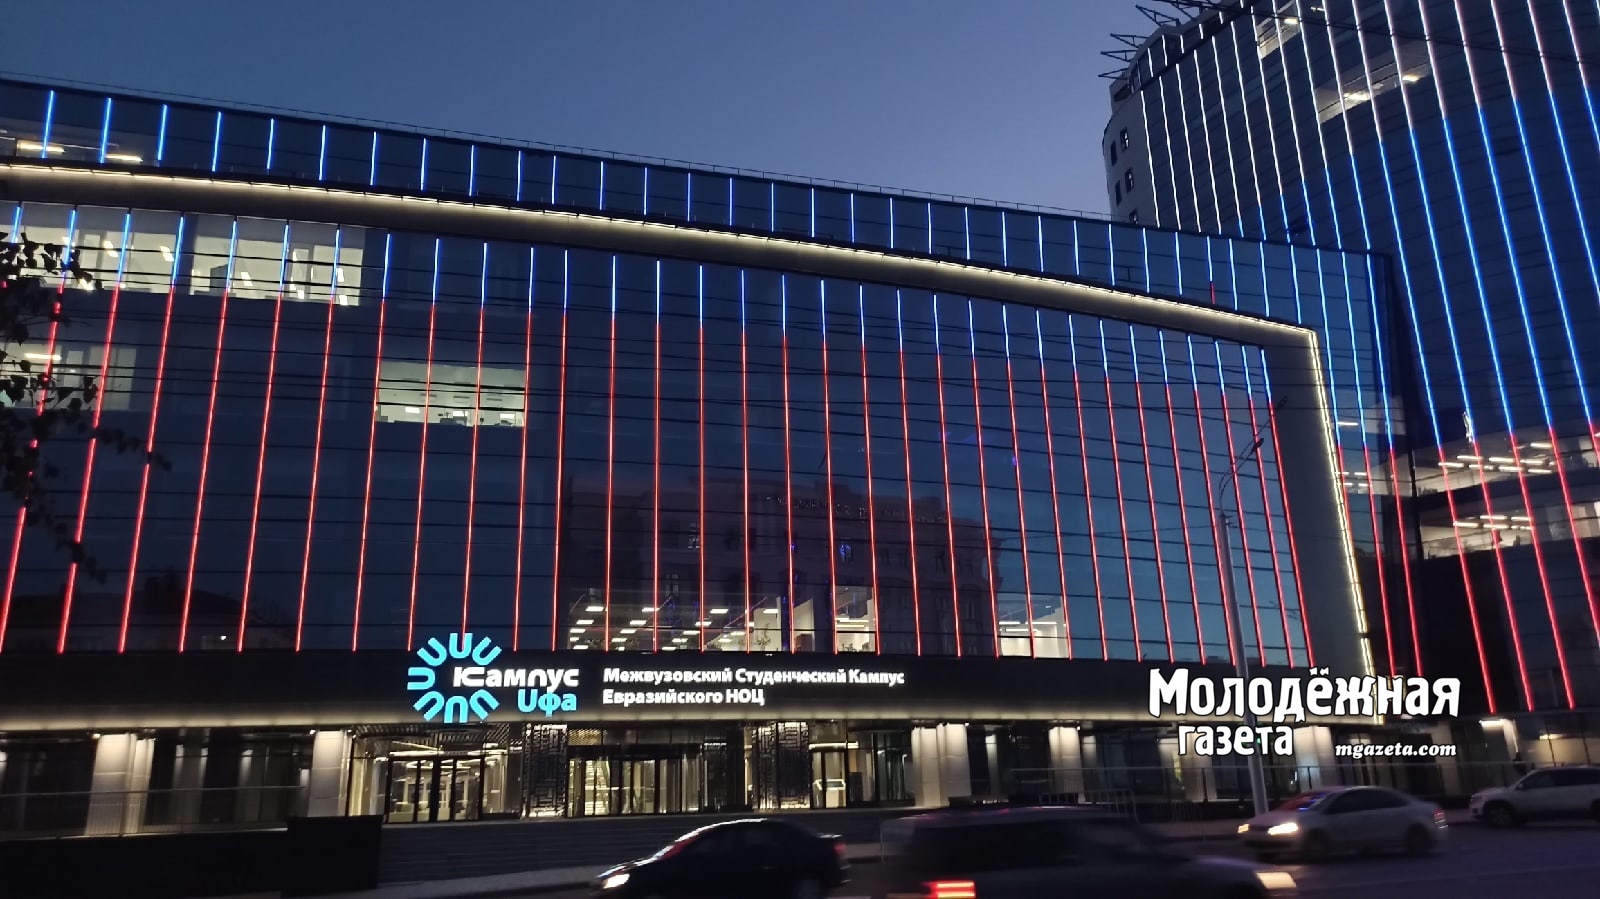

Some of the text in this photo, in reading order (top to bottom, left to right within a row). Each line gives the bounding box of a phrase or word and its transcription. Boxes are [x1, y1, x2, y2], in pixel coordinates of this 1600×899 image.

[453, 666, 579, 693] Кампус
[603, 667, 905, 687] Межвузовский Студенческий Кампус
[602, 688, 765, 707] Евразийского НОЦ
